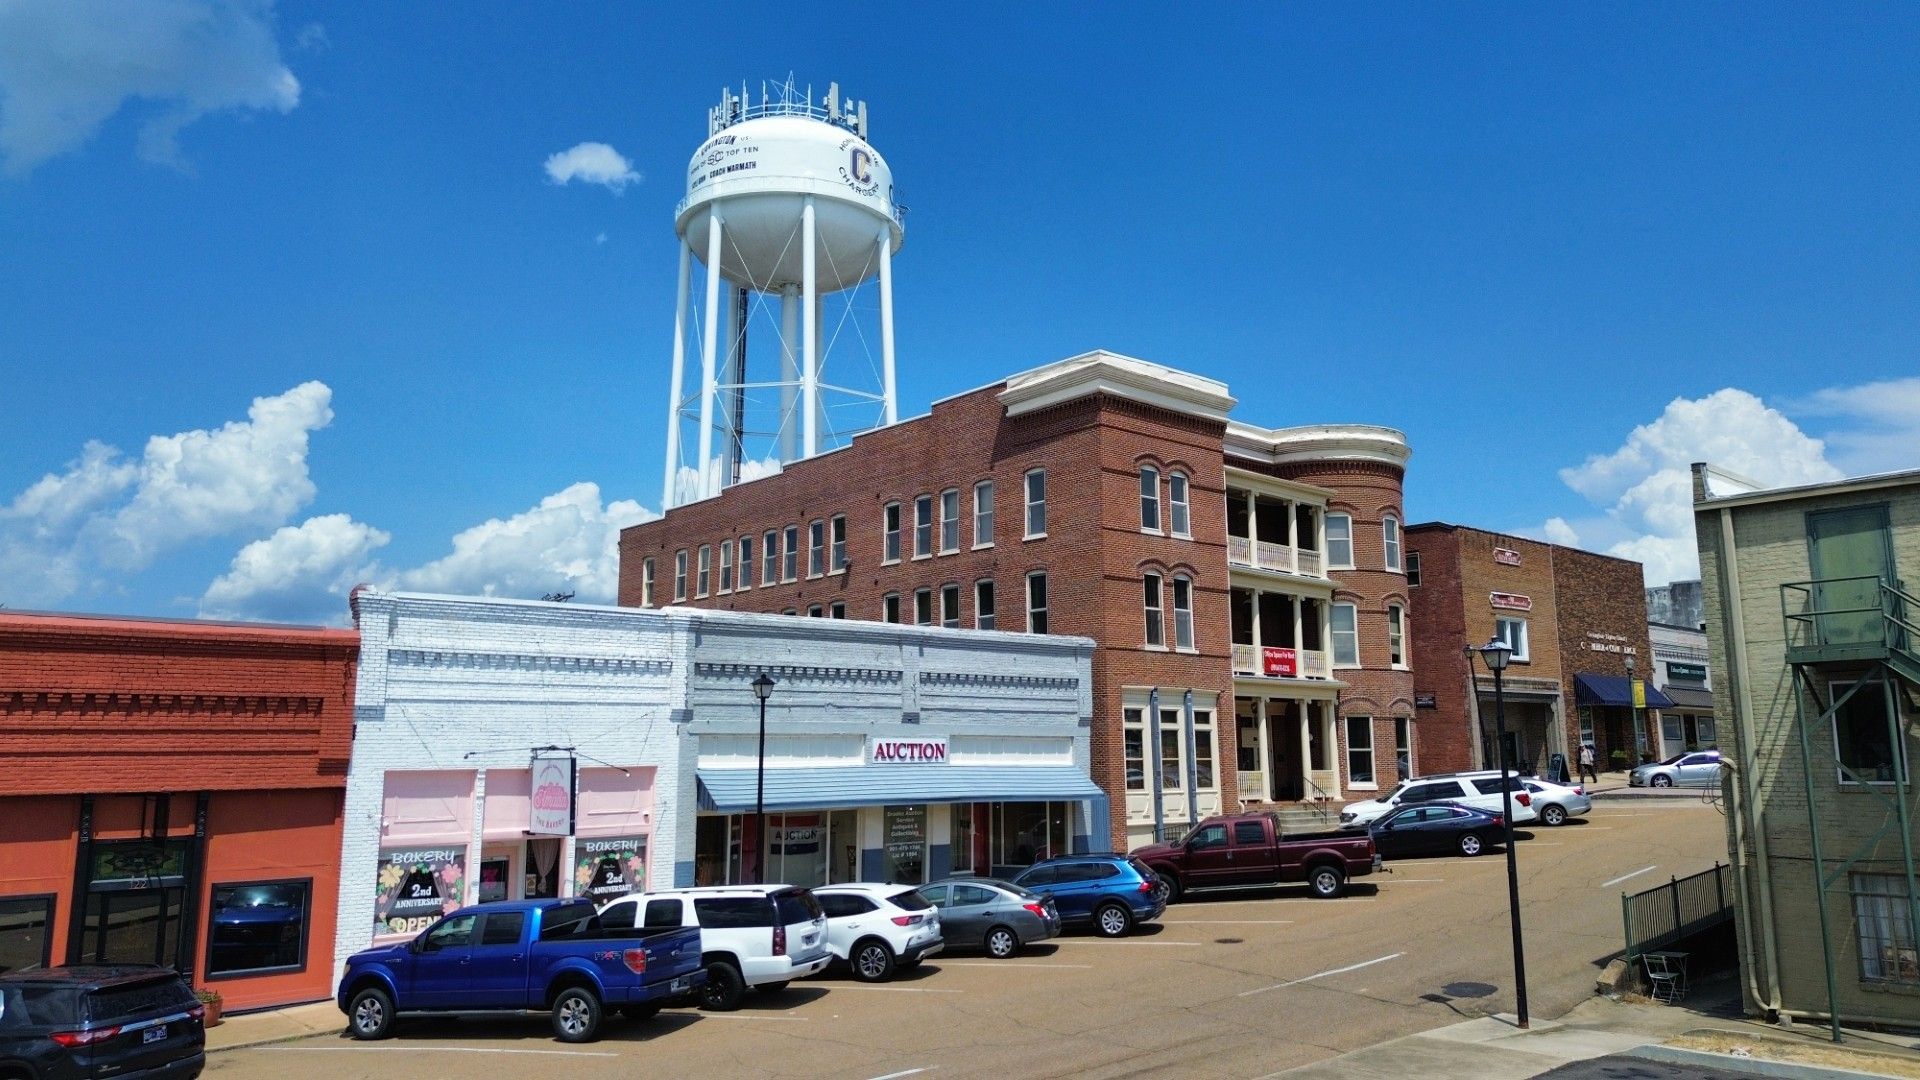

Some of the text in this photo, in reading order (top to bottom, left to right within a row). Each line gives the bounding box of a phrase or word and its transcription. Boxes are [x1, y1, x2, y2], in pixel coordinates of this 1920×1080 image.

[726, 148, 740, 157] TOP
[709, 160, 757, 179] COACH WARMATH
[874, 742, 946, 760] AUCTION
[606, 871, 623, 884] 2nd
[130, 880, 147, 890] 122
[411, 883, 432, 897] 2nd
[593, 883, 633, 895] ANNIVERSARY
[395, 897, 444, 909] ANNIVERSARY
